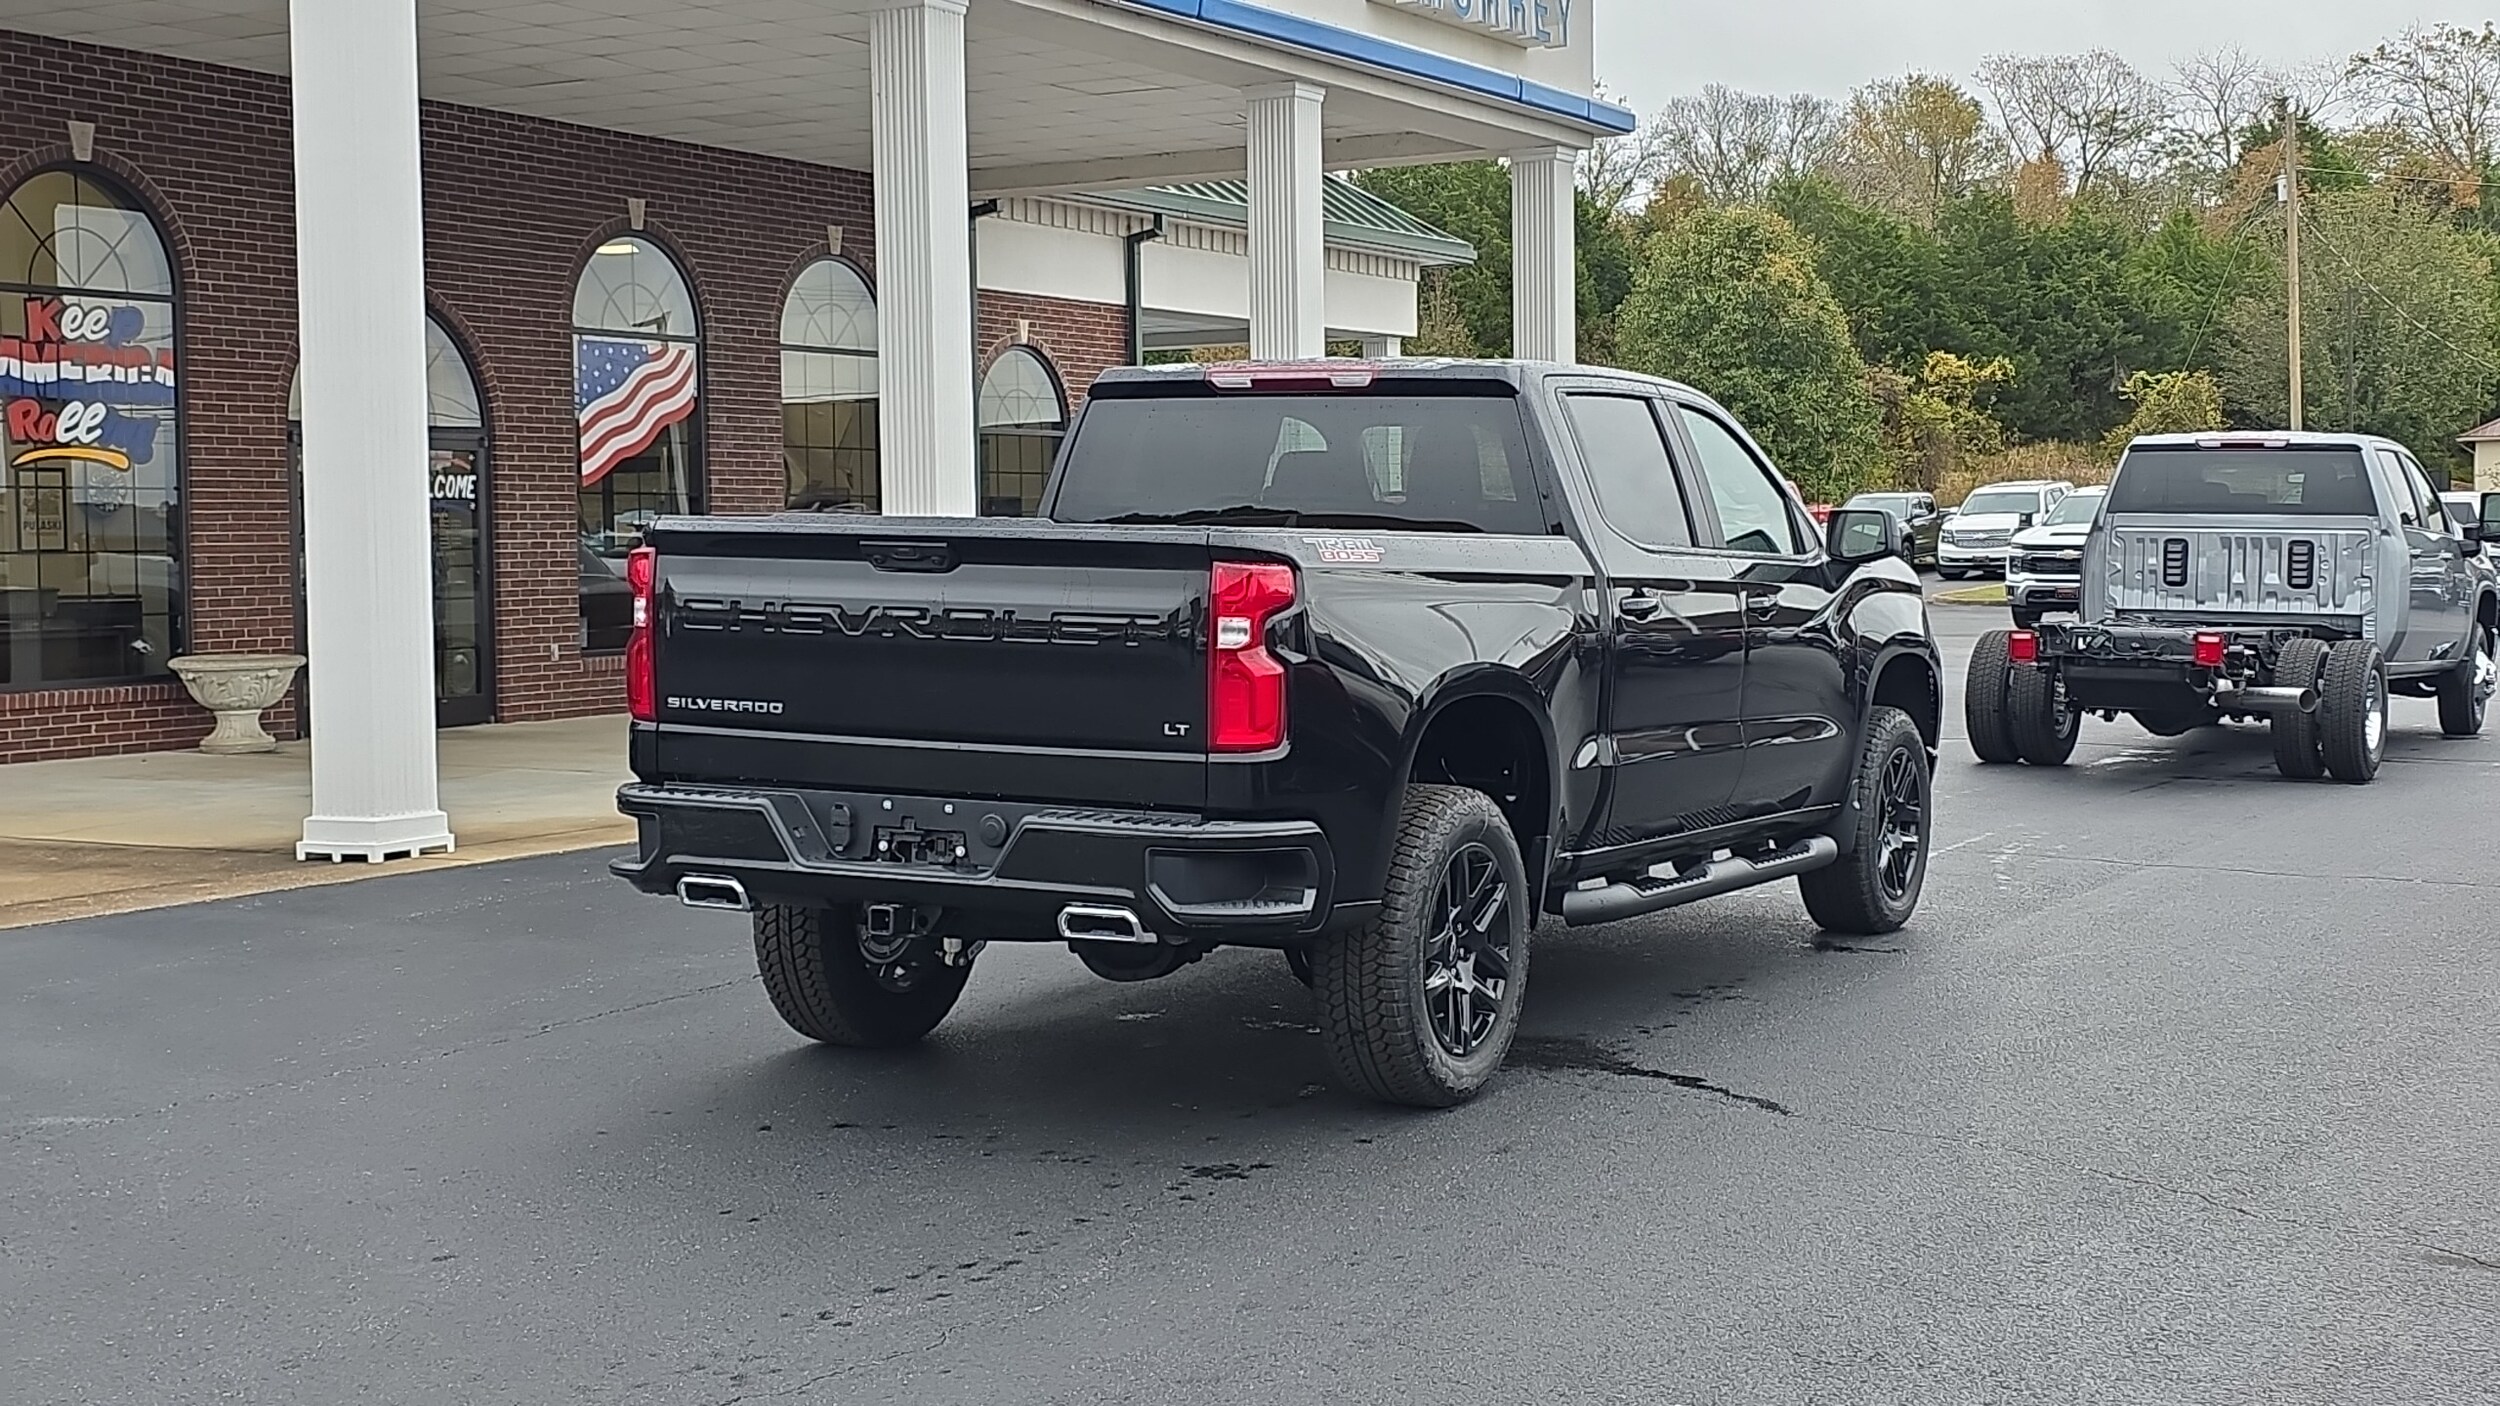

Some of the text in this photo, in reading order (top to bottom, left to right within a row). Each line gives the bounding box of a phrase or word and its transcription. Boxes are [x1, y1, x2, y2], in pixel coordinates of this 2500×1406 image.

[26, 298, 145, 347] Keep
[429, 474, 477, 499] COME
[24, 521, 61, 531] PUASKI
[1303, 537, 1386, 553] TRAIL
[1321, 550, 1380, 562] BOSS
[683, 599, 1161, 646] CHEVROLET
[667, 697, 784, 714] SILVERADO
[1163, 723, 1190, 736] LT
